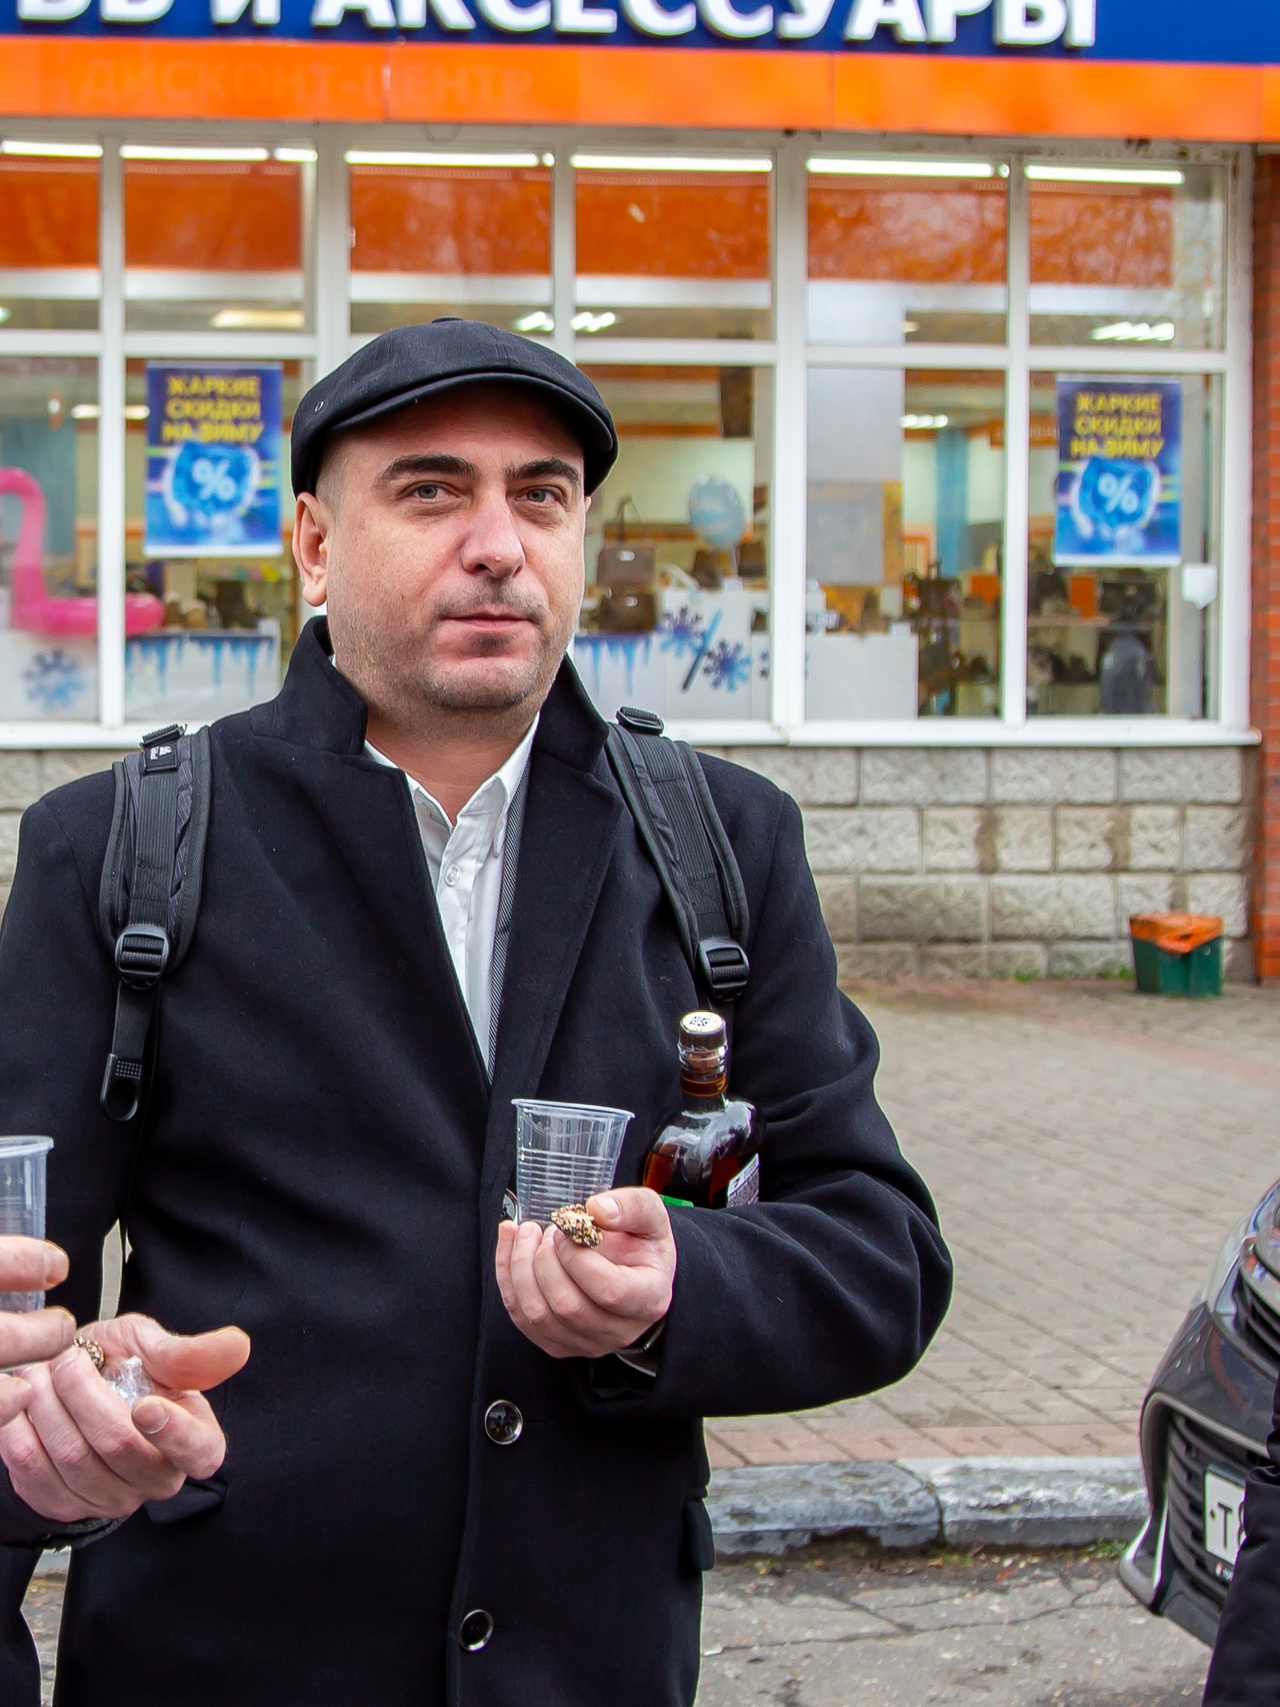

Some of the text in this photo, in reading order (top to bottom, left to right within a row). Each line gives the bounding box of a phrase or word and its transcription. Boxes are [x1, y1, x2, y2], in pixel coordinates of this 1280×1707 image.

[1076, 393, 1162, 412] ЖАРКИЕ
[1074, 415, 1162, 436] СКИДКИ
[1071, 437, 1165, 459] НА ЗИМУ
